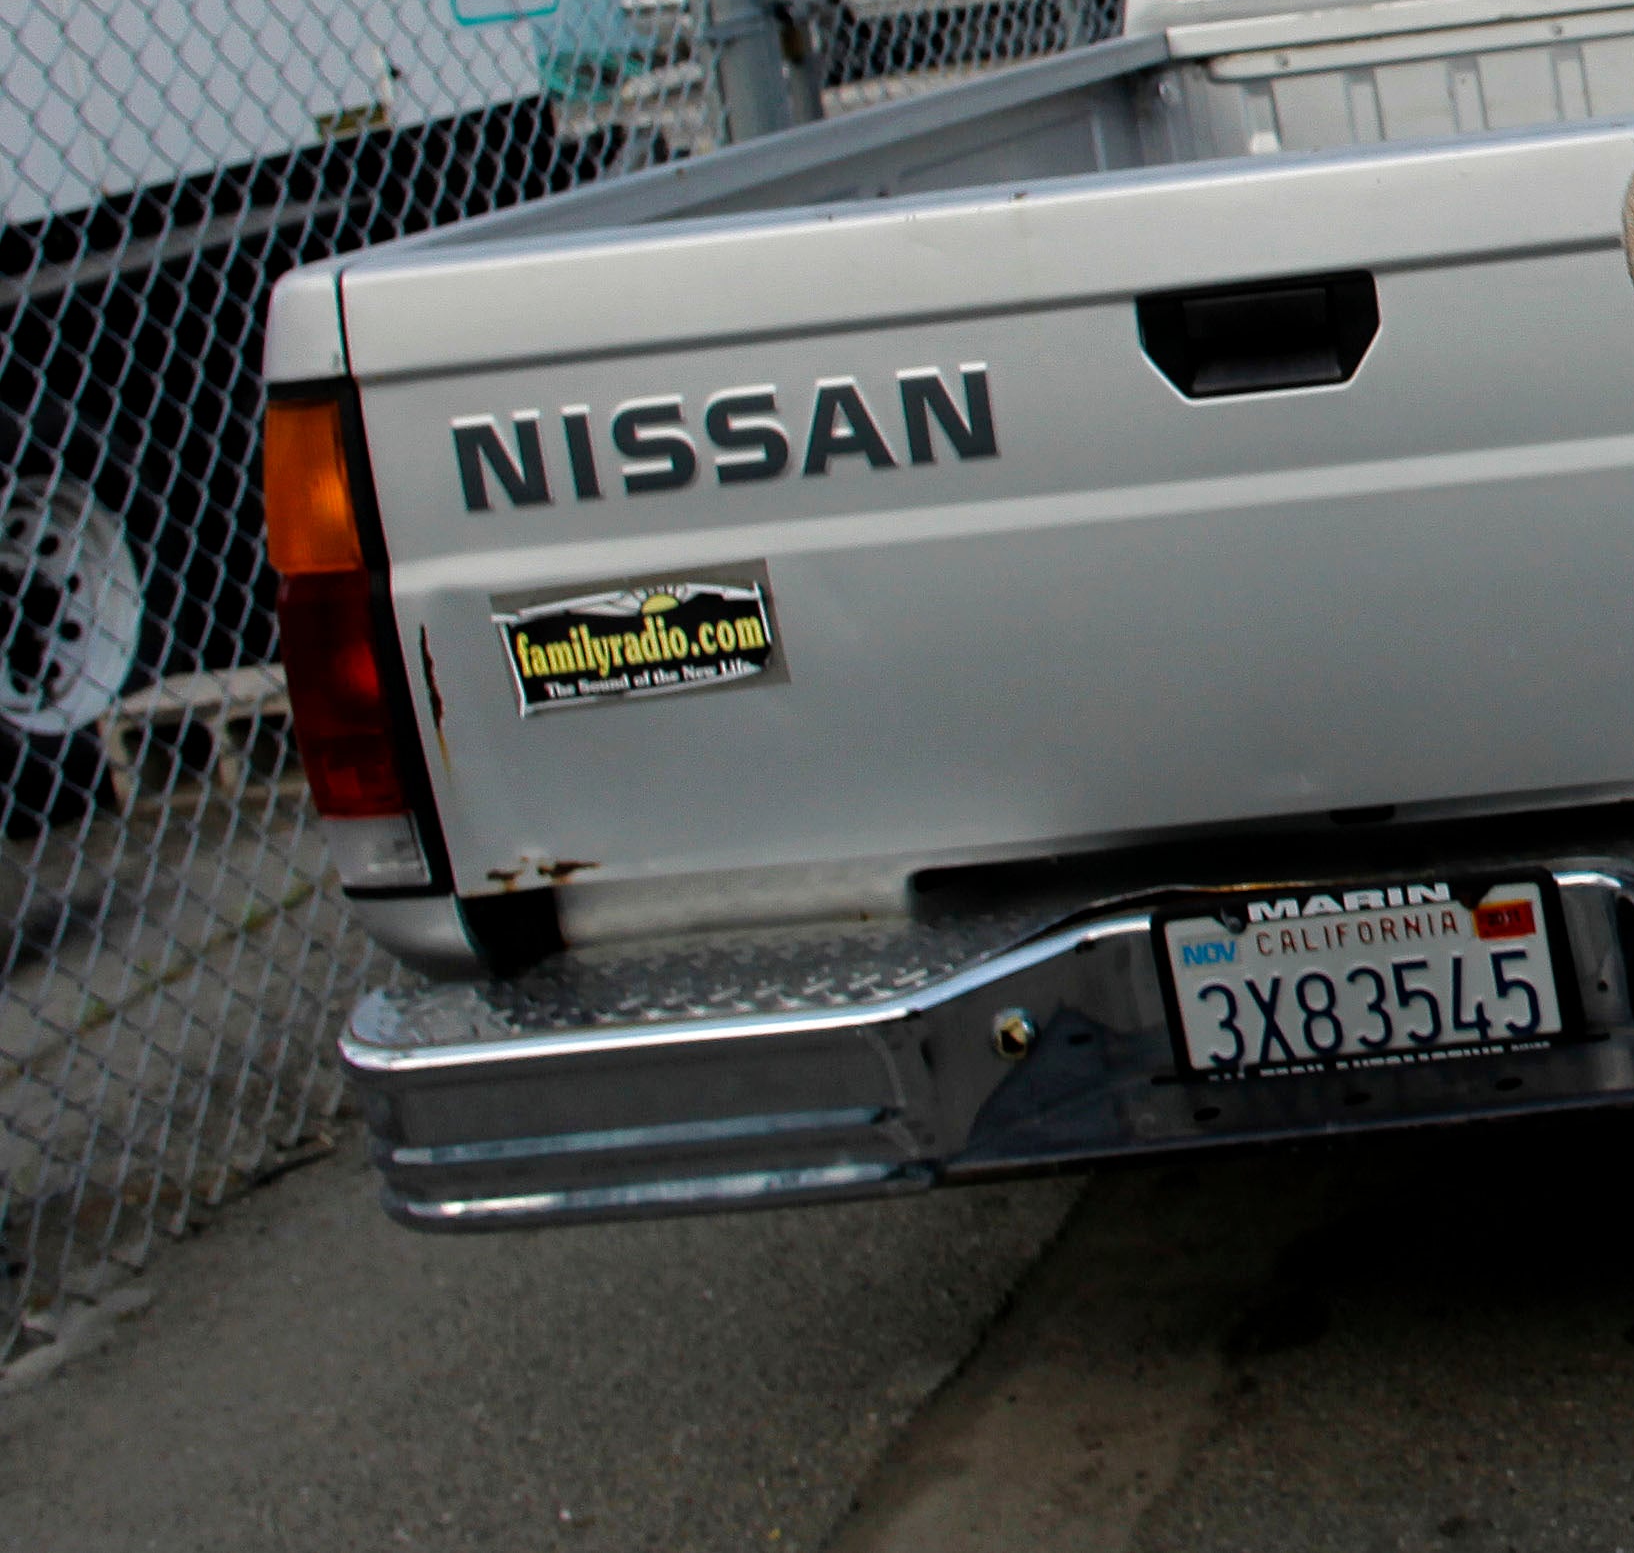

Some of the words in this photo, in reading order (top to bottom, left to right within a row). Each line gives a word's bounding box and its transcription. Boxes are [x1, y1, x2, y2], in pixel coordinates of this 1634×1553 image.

[449, 361, 1000, 512] NISSAN
[516, 615, 766, 678] familyradio.com
[544, 681, 576, 698] The
[578, 673, 630, 695] Sound
[633, 669, 651, 687] of
[653, 667, 679, 686] the
[681, 664, 717, 681] New
[1247, 882, 1451, 923] MARIN
[1183, 940, 1237, 967] NOV
[1256, 910, 1460, 957] CALIFORNIA
[1198, 949, 1541, 1067] 3X83545
